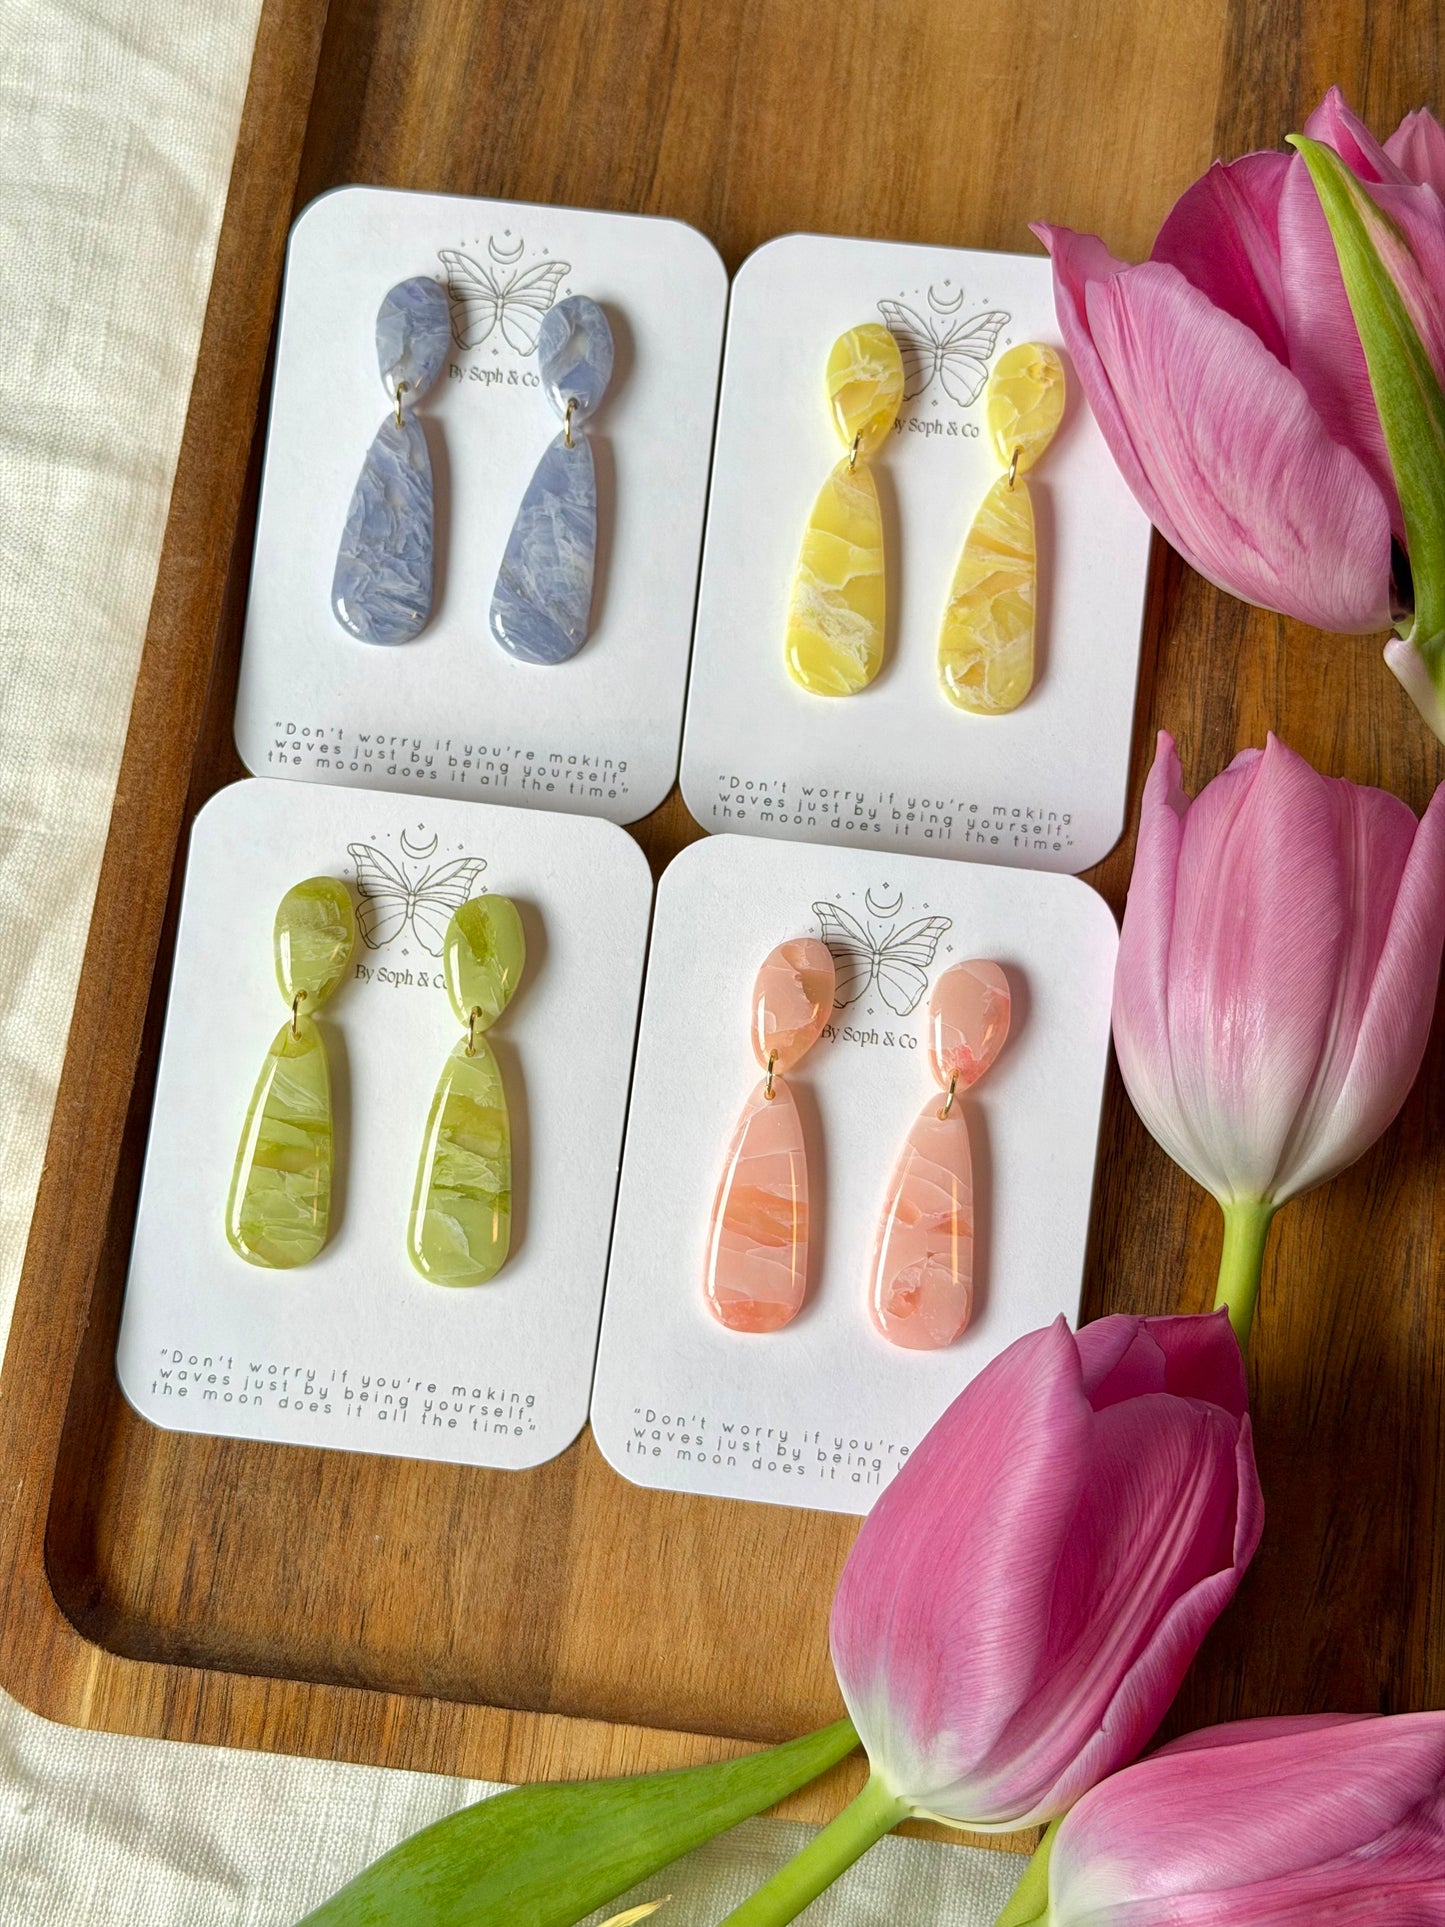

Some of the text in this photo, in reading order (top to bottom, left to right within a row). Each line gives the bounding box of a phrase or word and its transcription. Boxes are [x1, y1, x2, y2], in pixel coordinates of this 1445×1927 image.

[449, 364, 540, 388] By Soph & Co
[908, 417, 942, 438] Soph
[947, 421, 958, 436] &
[961, 423, 979, 438] Co
[275, 739, 625, 786] waves just by being yourself,
[276, 721, 628, 773] "Don't worry if you're making
[268, 751, 629, 798] the moon does it all the time"
[719, 776, 1071, 825] "Don't worry if you're making
[719, 793, 785, 808] waves
[798, 799, 839, 813] just
[854, 805, 877, 820] by
[892, 808, 952, 827] being
[713, 805, 1073, 851] the moon does it all the time"
[355, 964, 375, 984] By
[377, 967, 413, 988] Soph
[417, 972, 429, 987] &
[821, 1024, 918, 1049] By Soph & Co
[160, 1368, 532, 1423] waves just by being yourself,
[161, 1349, 535, 1408] "Don't worry if you're making
[152, 1381, 536, 1436] the moon does it all the time"
[633, 1427, 704, 1446] waves
[717, 1436, 761, 1453] just
[777, 1443, 801, 1461] by
[817, 1448, 881, 1472] being
[634, 1408, 909, 1456] "Don't worry if you're
[626, 1440, 880, 1485] the moon does it all
